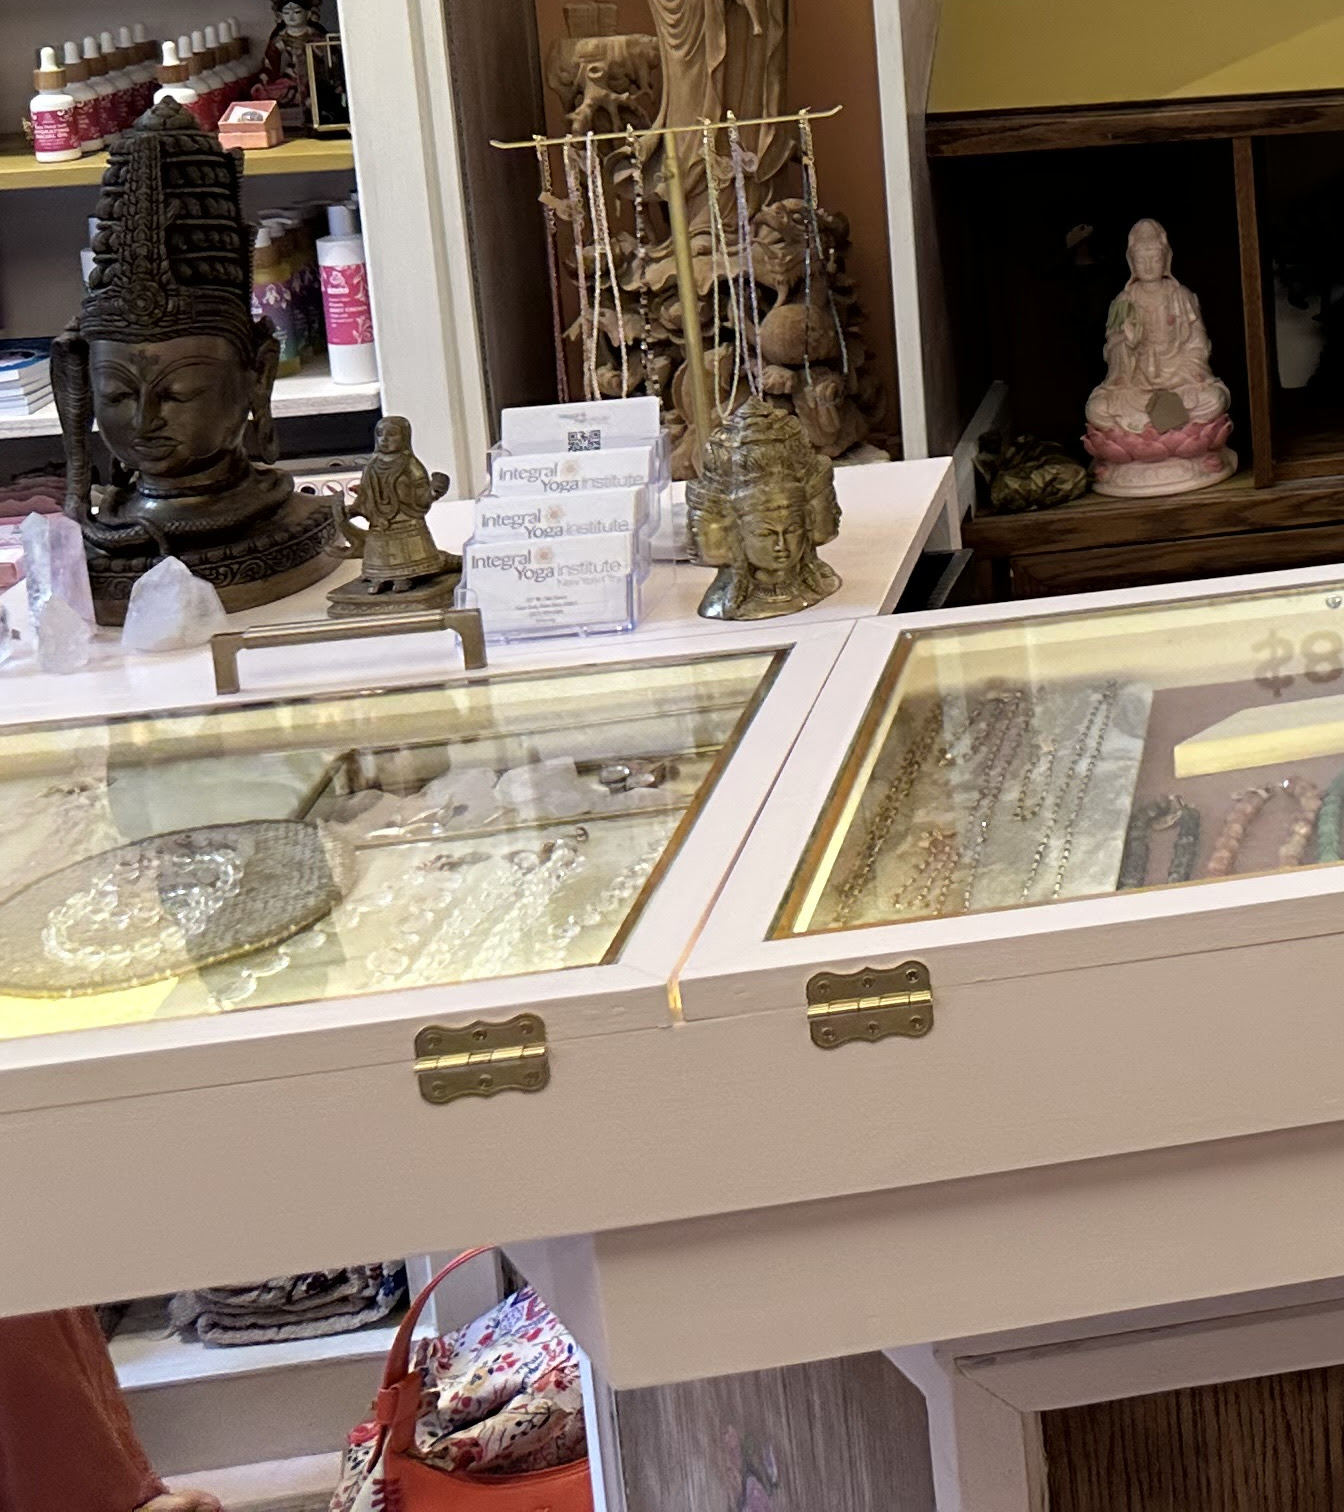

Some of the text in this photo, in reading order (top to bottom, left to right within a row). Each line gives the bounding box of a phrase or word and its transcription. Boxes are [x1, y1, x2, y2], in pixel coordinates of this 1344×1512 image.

[499, 462, 558, 483] Integral
[541, 478, 579, 493] Yoga
[482, 508, 542, 529] Integral
[524, 524, 563, 538] Yoga
[471, 550, 532, 571] Integral
[514, 566, 555, 583] Yoga
